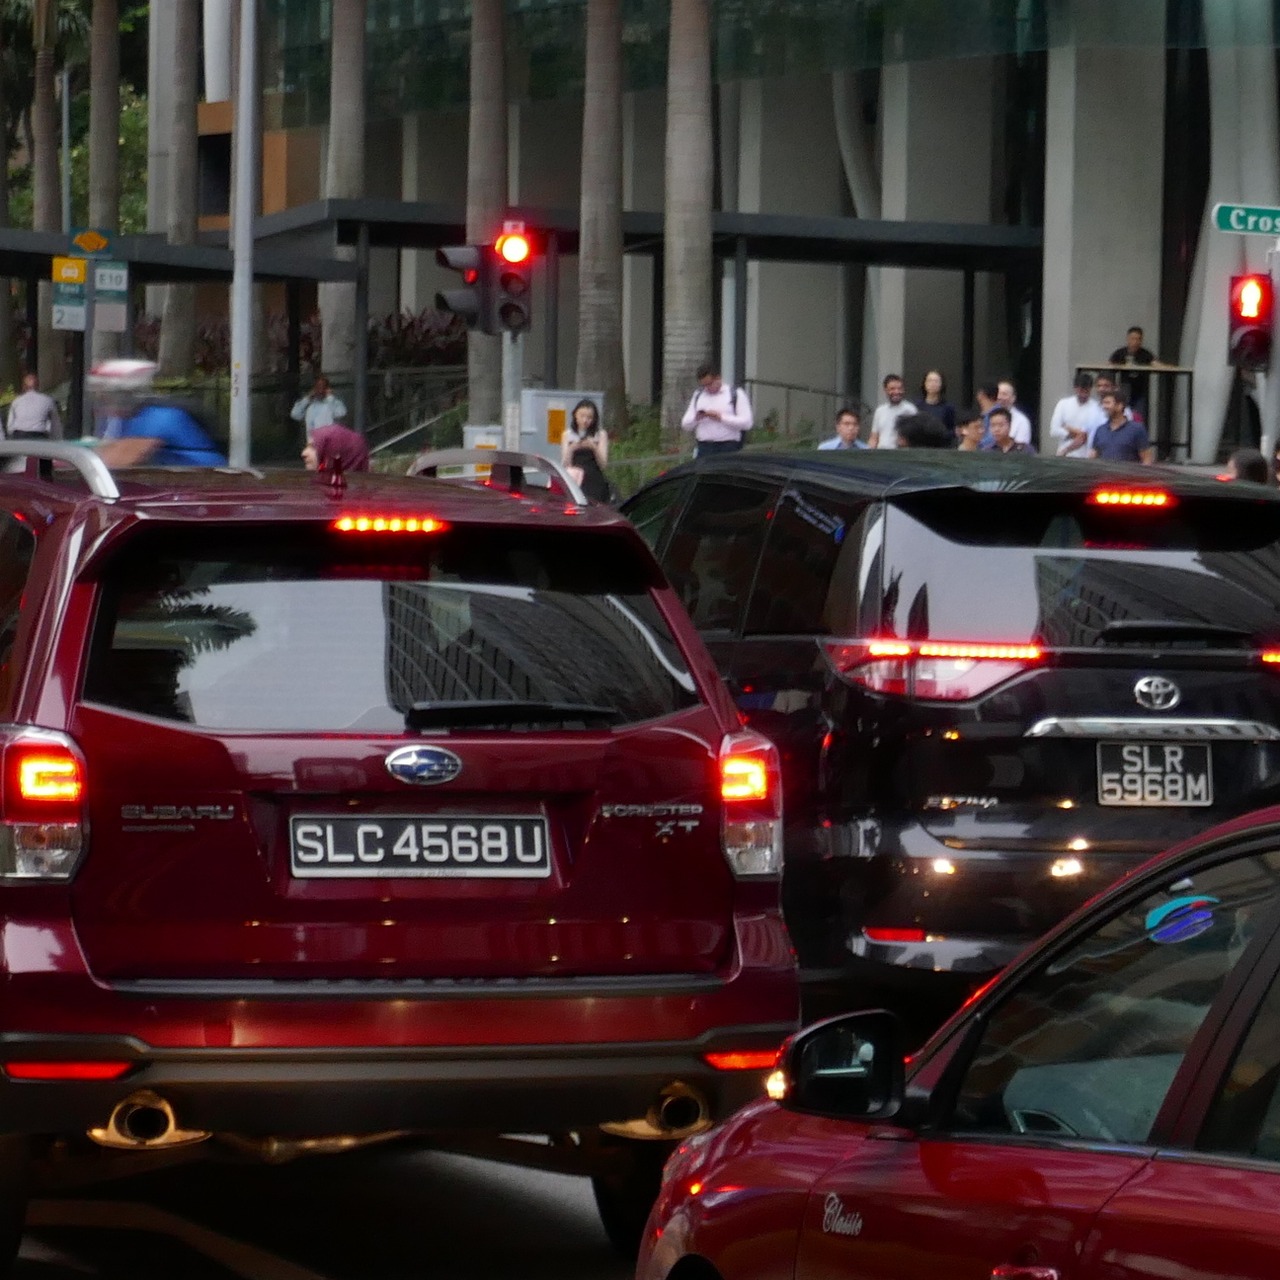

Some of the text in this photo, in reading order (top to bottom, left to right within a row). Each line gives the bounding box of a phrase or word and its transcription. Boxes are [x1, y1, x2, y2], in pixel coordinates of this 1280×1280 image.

[1122, 745, 1184, 773] SLR
[1101, 772, 1208, 802] 5968M
[120, 804, 235, 820] SUBARU
